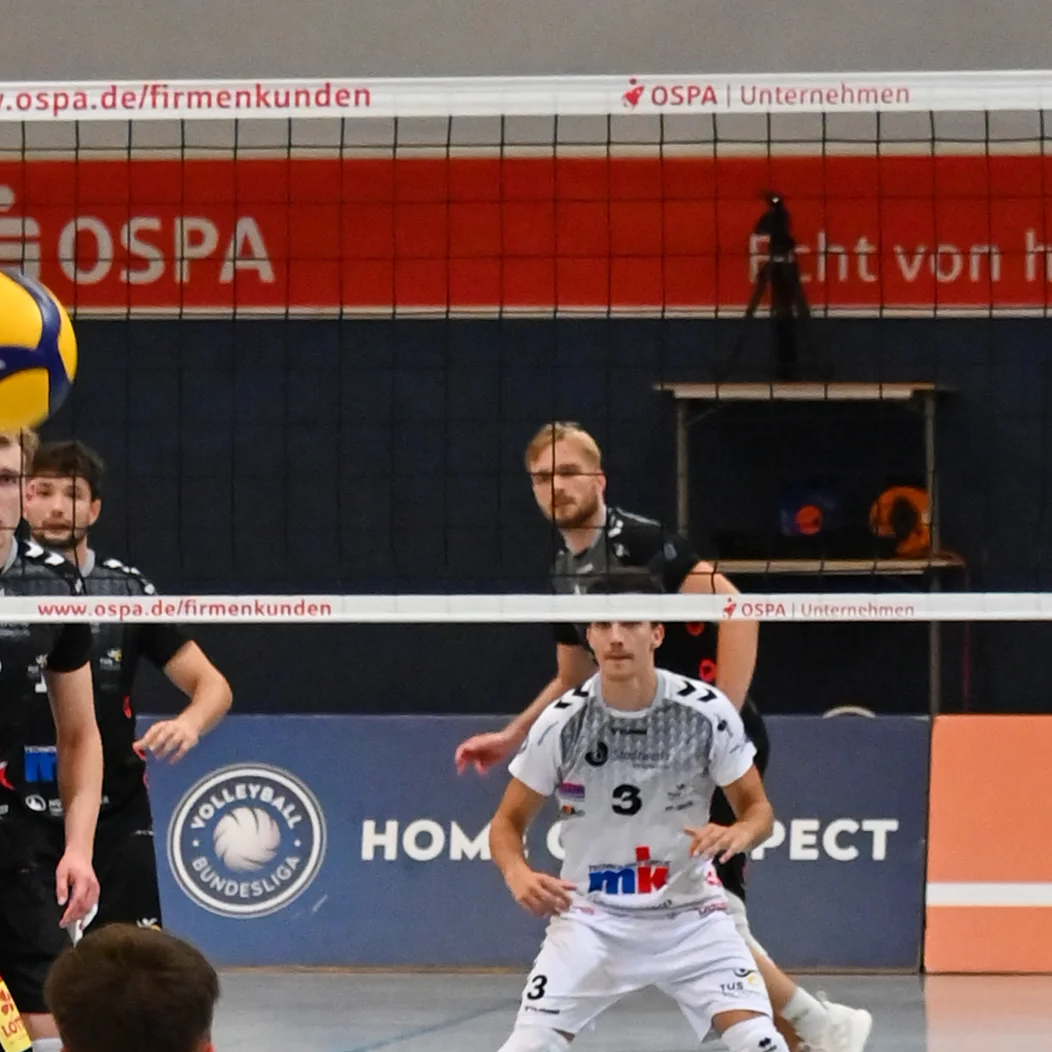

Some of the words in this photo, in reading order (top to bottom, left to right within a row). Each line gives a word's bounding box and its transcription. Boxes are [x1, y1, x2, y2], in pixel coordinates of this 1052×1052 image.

[651, 85, 718, 106] OSPA
[740, 82, 910, 106] Unternehmen
[58, 216, 275, 285] OSPA
[894, 245, 1001, 283] von
[38, 600, 332, 621] www.ospa.de/firmenkunden
[741, 603, 786, 617] OSPA
[800, 602, 914, 618] Unternehmen
[191, 783, 302, 830] VOLLEYBALL
[612, 784, 643, 816] 3
[361, 819, 529, 861] HOM
[192, 855, 300, 898] BUNDESLIGA
[527, 975, 548, 1000] 3
[719, 982, 744, 993] TUS
